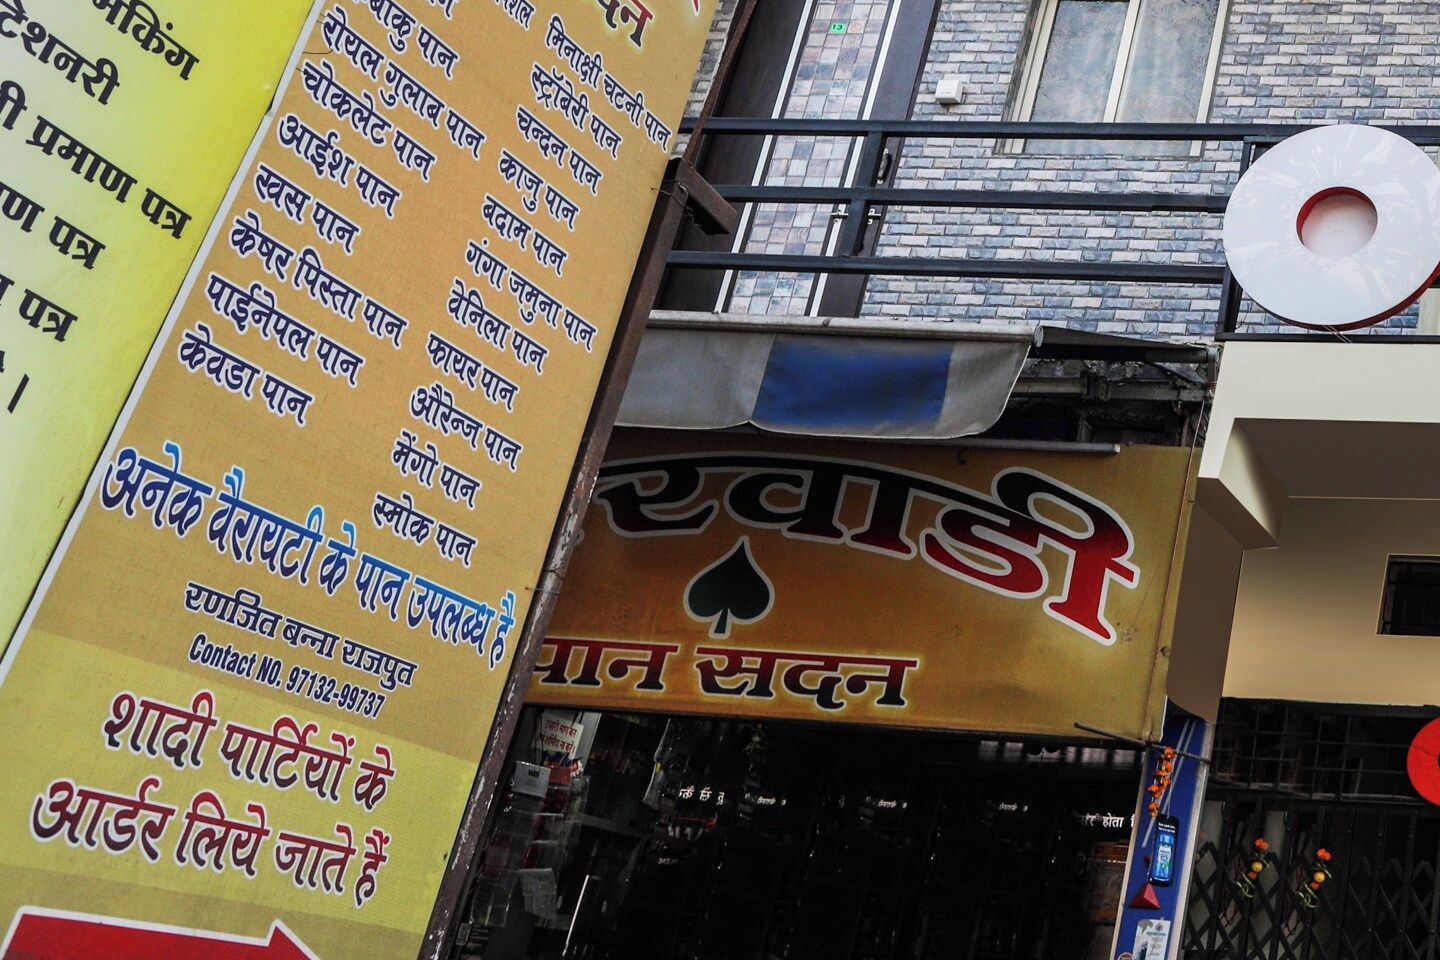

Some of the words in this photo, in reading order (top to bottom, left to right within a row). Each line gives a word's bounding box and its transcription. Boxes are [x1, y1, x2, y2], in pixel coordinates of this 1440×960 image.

[323, 7, 384, 79] रोयल
[380, 62, 445, 126] गुलाब
[447, 110, 484, 158] पान
[418, 27, 457, 77] पान
[303, 62, 391, 144] चोकलेट
[394, 130, 435, 180] पान
[518, 107, 568, 166] चन्दन
[570, 151, 601, 193] पान
[591, 115, 621, 157] पान
[604, 74, 644, 126] चटनी
[645, 112, 671, 150] पान
[26, 116, 137, 203] प्रमाण
[142, 188, 191, 239] पत्र
[256, 165, 311, 221] खस
[313, 202, 359, 252] पान
[357, 166, 399, 216] पान
[500, 151, 543, 211] काजु
[546, 186, 578, 229] पान
[50, 216, 105, 269] पत्र
[484, 196, 531, 248] बदाम
[533, 232, 566, 275] पान
[20, 289, 78, 342] पत्र
[232, 212, 294, 279] केषर
[294, 249, 361, 319] पिस्ता
[364, 299, 407, 346] पान
[467, 240, 508, 289] गंगा
[510, 271, 562, 326] जमुना
[564, 310, 596, 350] पान
[208, 275, 315, 357] पाईनेपल
[317, 337, 363, 385] पान
[449, 279, 510, 348] वेनिला
[512, 331, 547, 372] पान
[181, 324, 260, 397] केवडा
[263, 375, 312, 424] पान
[428, 334, 481, 388] फायर
[481, 368, 518, 410] पान
[393, 431, 439, 486] मेंगो
[441, 465, 480, 507] पान
[485, 428, 521, 469] पान
[103, 443, 212, 536] अनेक
[209, 468, 325, 584] वैरायटी
[318, 522, 356, 596] के
[355, 554, 410, 619] पान
[407, 578, 494, 655] उपलब्ध
[490, 591, 515, 668] है
[374, 494, 434, 543] स्मोक
[436, 524, 476, 566] पान
[598, 453, 1138, 641] रवाडी
[185, 583, 283, 638] रणजित
[283, 618, 340, 658] बन्ना
[342, 639, 418, 691] राजपुत
[189, 634, 256, 678] Contact
[256, 657, 283, 687] NO.
[286, 667, 386, 718] 97132-99737
[534, 638, 679, 690] पान
[696, 646, 918, 708] सदन
[104, 692, 217, 767] शादी
[221, 718, 354, 801] पार्टियों
[355, 746, 394, 810] के
[33, 778, 175, 860] आर्डर
[176, 792, 270, 876] लिये
[276, 825, 356, 892] जाते
[356, 829, 389, 906] हैं
